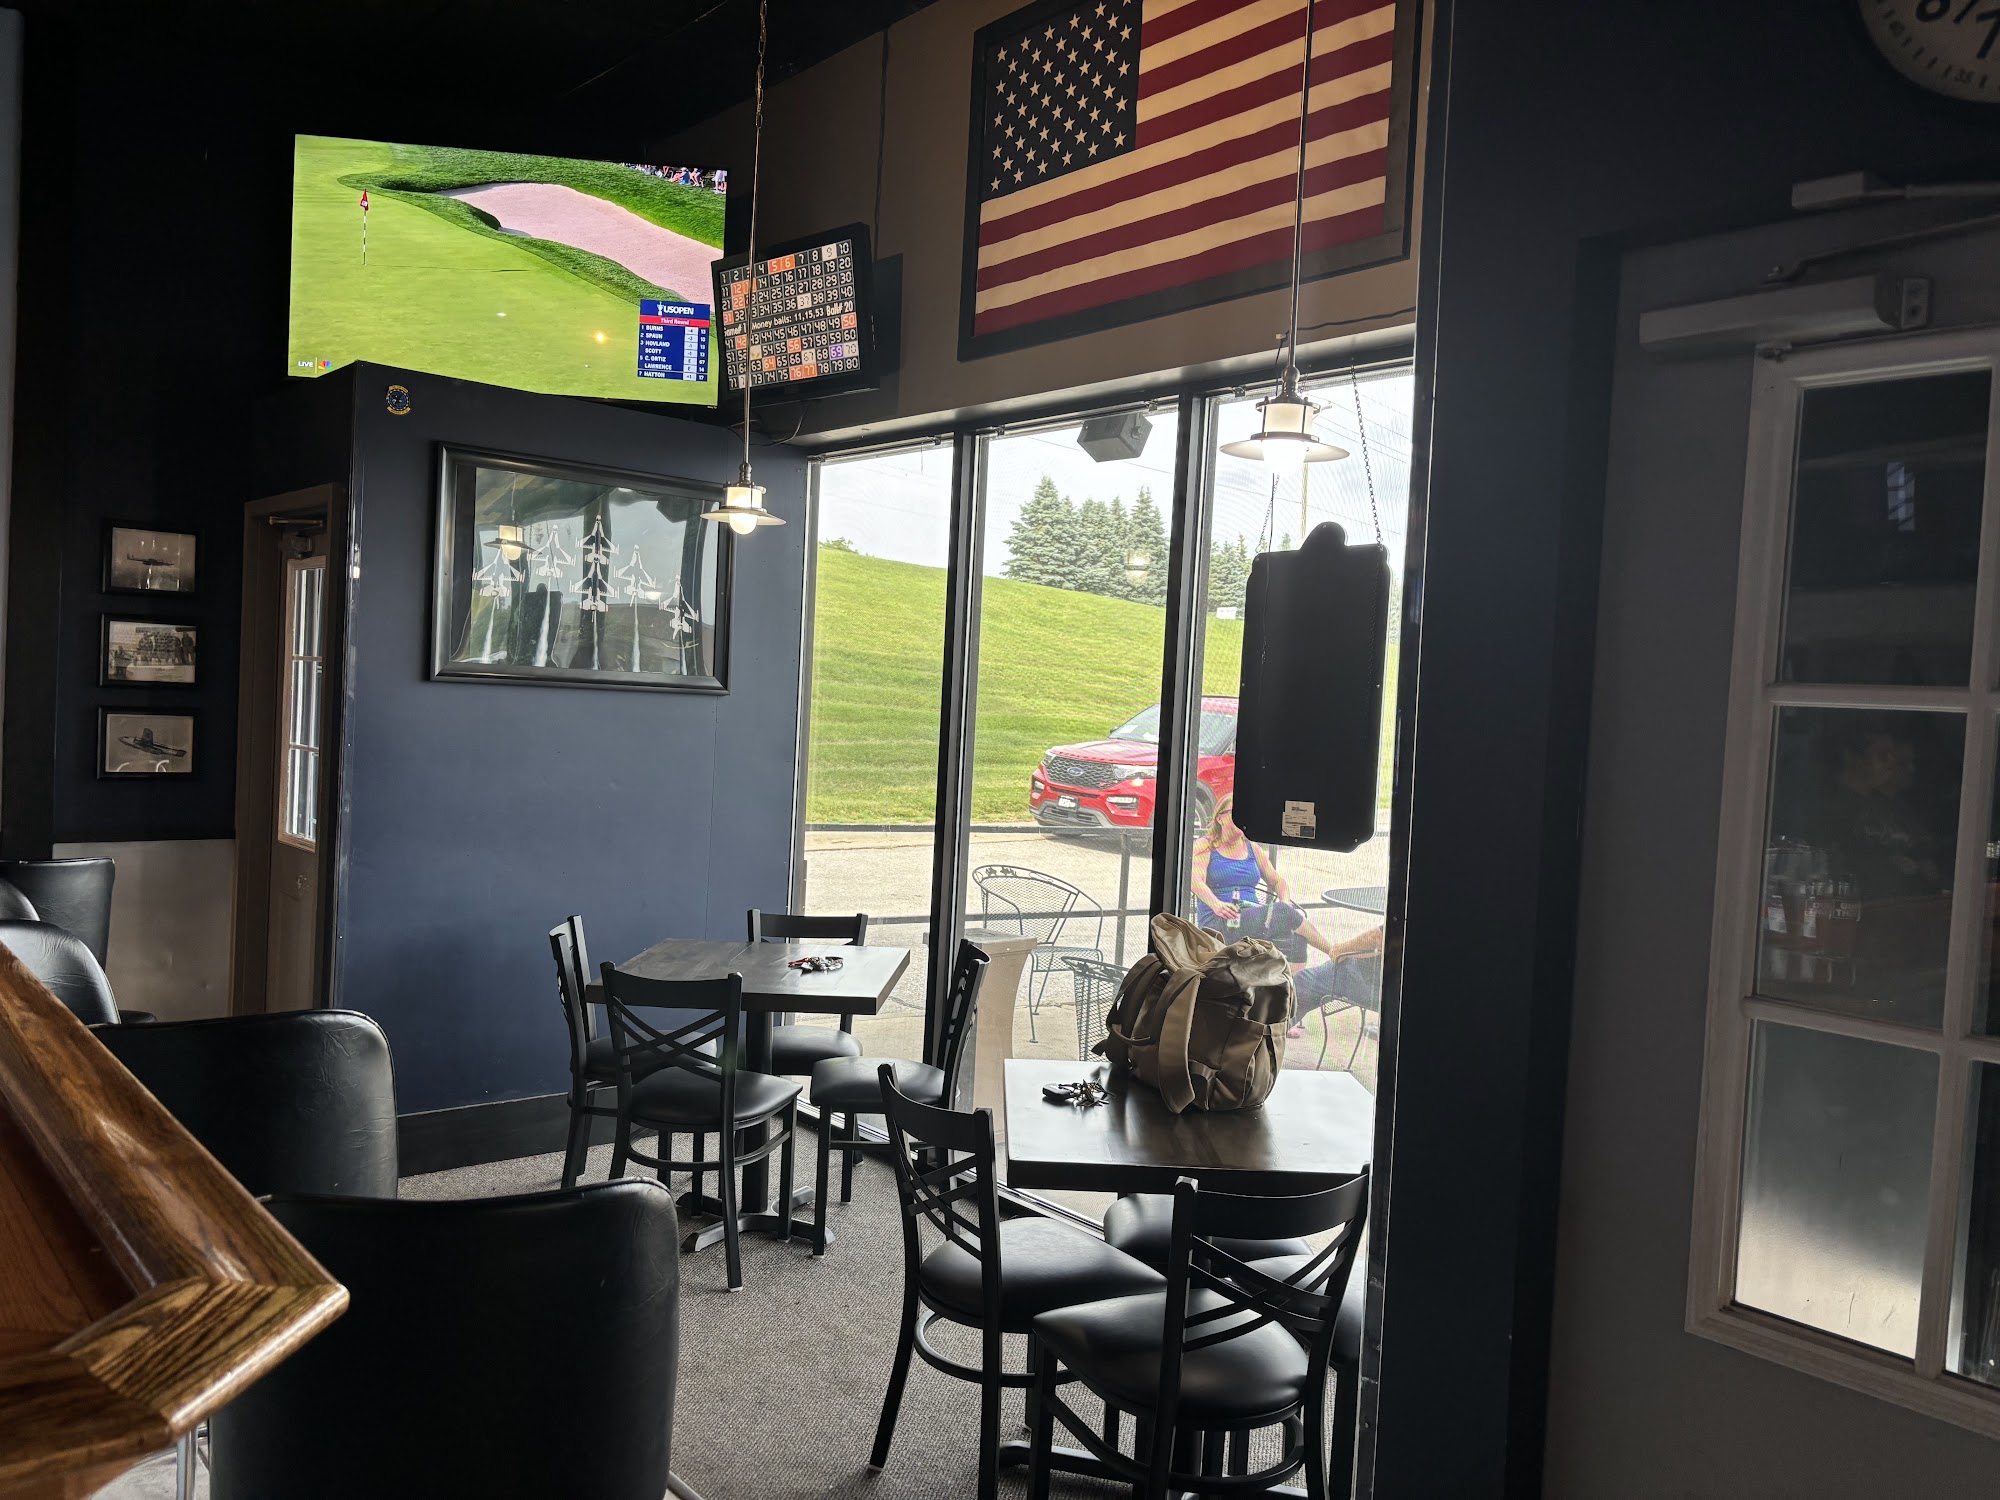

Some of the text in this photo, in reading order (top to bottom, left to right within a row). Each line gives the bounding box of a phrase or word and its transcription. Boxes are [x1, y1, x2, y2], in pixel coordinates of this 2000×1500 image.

[721, 273, 726, 284] 1
[733, 270, 739, 281] 2
[758, 263, 765, 274] 4
[771, 260, 778, 271] 5
[784, 257, 791, 268] 6
[798, 253, 805, 264] 7
[812, 250, 819, 261] 8
[826, 246, 833, 258] 9
[838, 242, 850, 255] 10
[721, 286, 729, 298] 11
[733, 283, 742, 295] 12
[758, 277, 767, 289] 14
[771, 274, 780, 286] 15
[784, 270, 794, 283] 16
[798, 267, 807, 279] 17
[811, 264, 821, 276] 18
[825, 260, 836, 273] 19
[839, 256, 851, 270] 20
[721, 299, 730, 311] 21
[733, 297, 743, 309] 22
[758, 290, 769, 303] 24
[771, 287, 782, 300] 25
[784, 284, 796, 297] 26
[798, 281, 809, 294] 27
[811, 278, 823, 290] 28
[825, 274, 838, 287] 29
[839, 271, 852, 284] 30
[723, 313, 732, 324] 31
[734, 310, 745, 322] 32
[760, 304, 771, 316] 34
[772, 301, 783, 313] 35
[785, 298, 797, 311] 36
[799, 295, 810, 307] 37
[812, 292, 824, 305] 38
[826, 288, 839, 302] 39
[840, 285, 853, 298] 40
[724, 338, 734, 350] 41
[750, 333, 760, 345] 43
[761, 331, 773, 342] 44
[774, 328, 786, 340] 45
[787, 325, 799, 337] 46
[800, 323, 812, 334] 47
[814, 320, 827, 332] 48
[828, 317, 841, 329] 49
[842, 314, 855, 327] 50
[751, 319, 773, 330] Money
[843, 300, 854, 313] 20
[726, 351, 735, 363] 51
[762, 344, 774, 356] 54
[775, 341, 787, 354] 55
[788, 339, 800, 350] 56
[801, 337, 813, 349] 57
[815, 334, 828, 347] 58
[829, 331, 841, 344] 59
[843, 328, 856, 341] 60
[727, 364, 737, 376] 61
[751, 360, 762, 372] 63
[764, 357, 774, 369] 64
[776, 355, 788, 367] 65
[789, 353, 801, 365] 66
[803, 351, 814, 362] 67
[816, 348, 829, 360] 68
[830, 345, 843, 358] 69
[845, 343, 857, 354] 70
[298, 360, 313, 368] LIVE
[728, 378, 738, 388] 71
[752, 373, 763, 385] 73
[765, 371, 776, 382] 74
[777, 369, 789, 380] 75
[790, 367, 802, 378] 76
[804, 365, 815, 376] 77
[817, 362, 830, 374] 78
[831, 359, 844, 372] 79
[845, 357, 859, 370] 80
